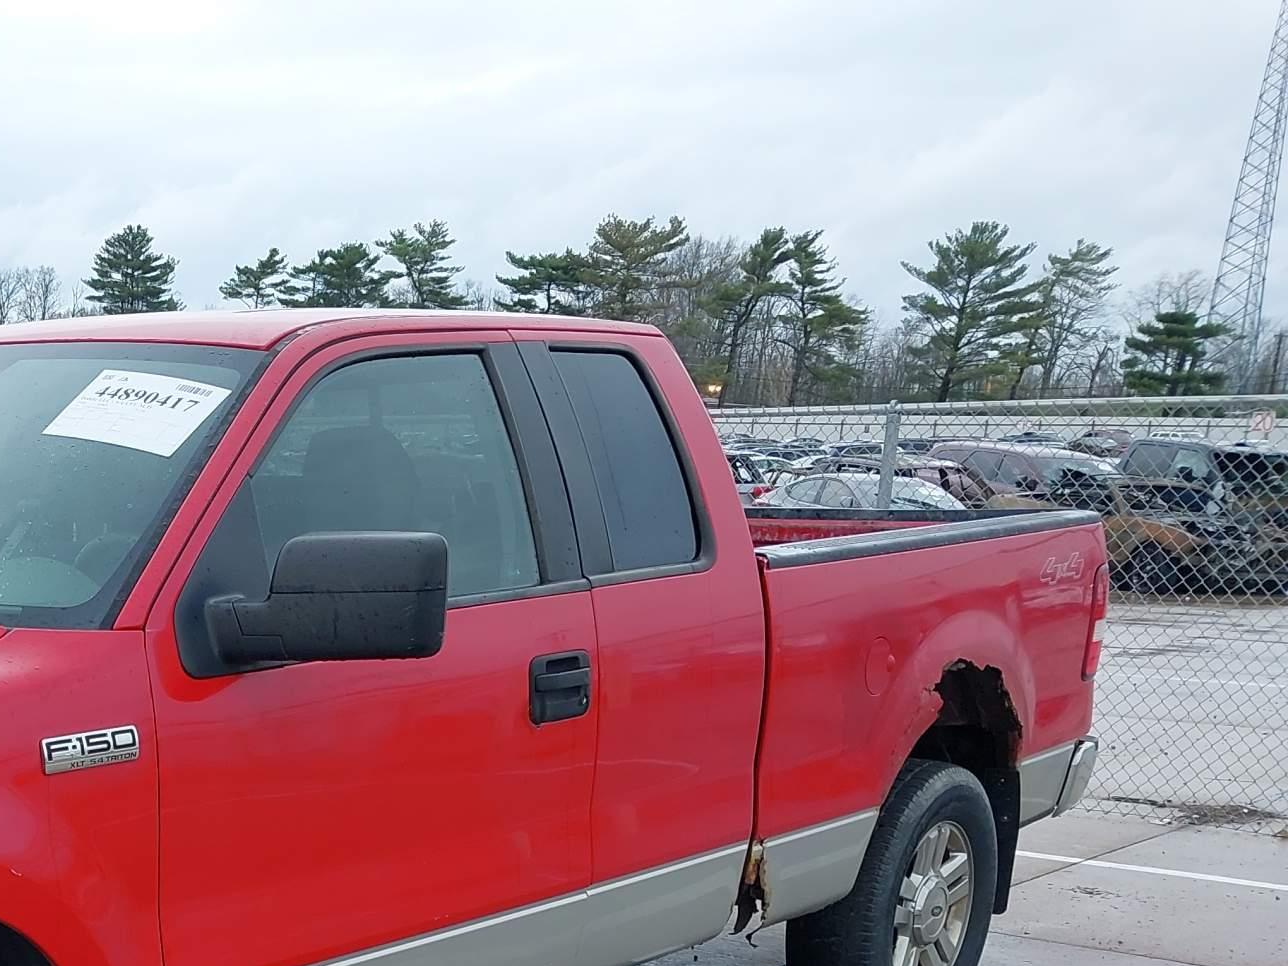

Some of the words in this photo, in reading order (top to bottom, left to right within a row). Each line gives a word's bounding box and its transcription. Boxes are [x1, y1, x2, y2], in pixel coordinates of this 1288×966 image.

[95, 385, 201, 412] 44890417
[1252, 412, 1272, 431] 20
[45, 728, 137, 762] F-150
[70, 761, 85, 769] XLT
[105, 751, 137, 763] TRITON
